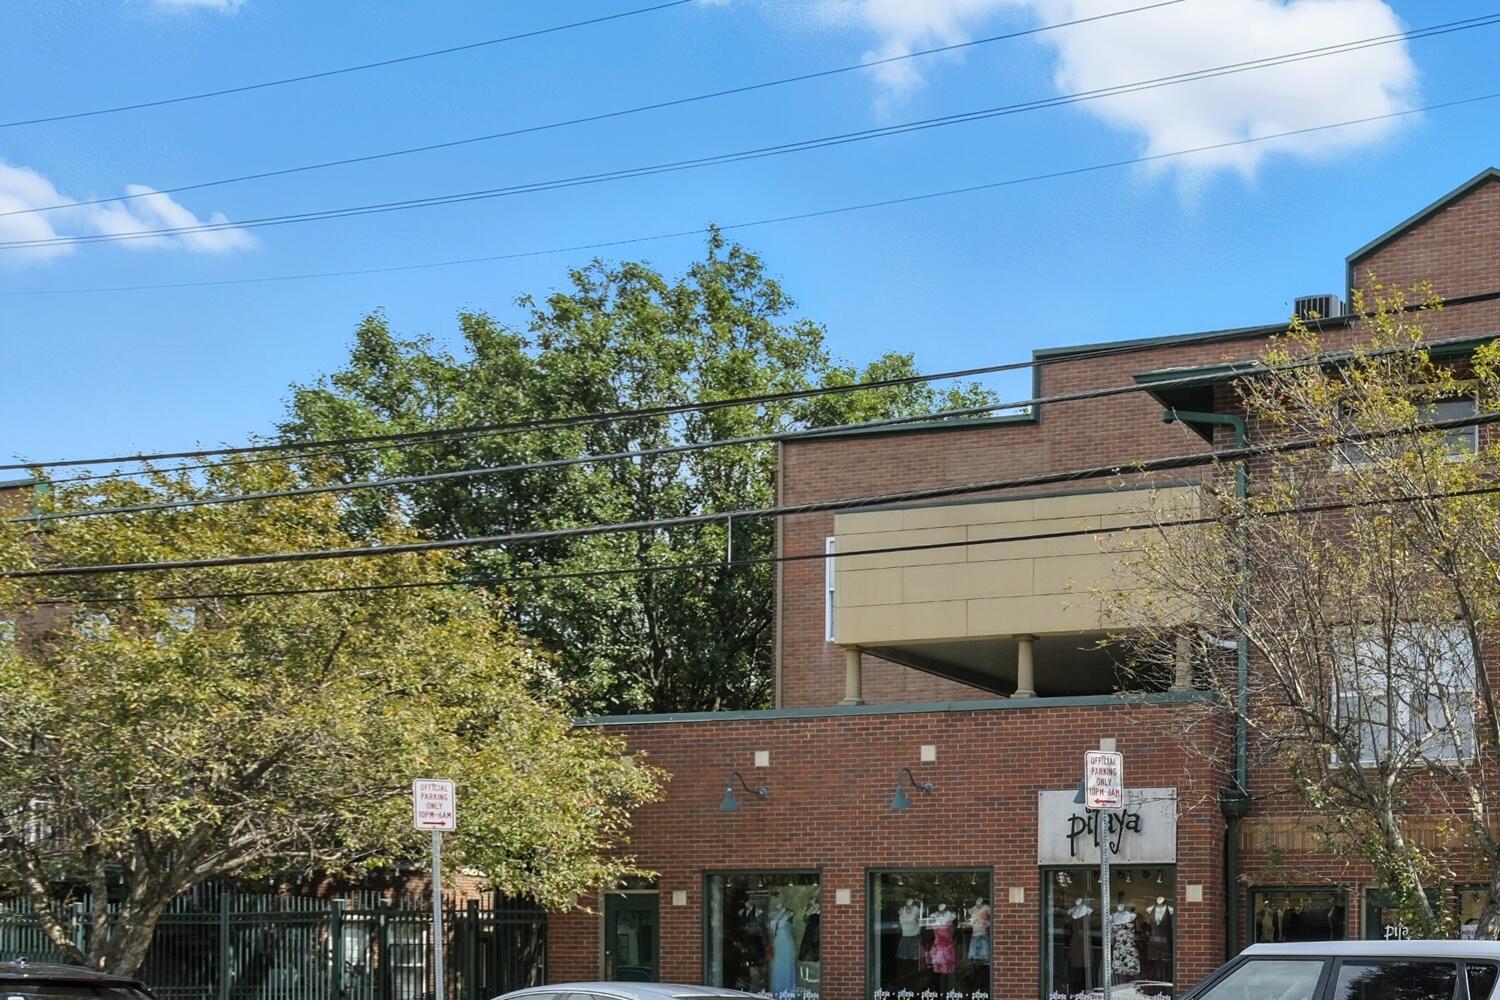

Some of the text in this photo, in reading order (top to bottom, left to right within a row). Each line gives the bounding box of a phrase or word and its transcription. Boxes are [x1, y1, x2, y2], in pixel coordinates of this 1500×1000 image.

[1090, 755, 1117, 765] OFFICIAL
[1091, 767, 1117, 776] PARKING
[1096, 778, 1112, 786] ONLY
[419, 784, 449, 792] OFFICIAL
[420, 792, 448, 801] PARKING
[426, 802, 443, 810] ONLY
